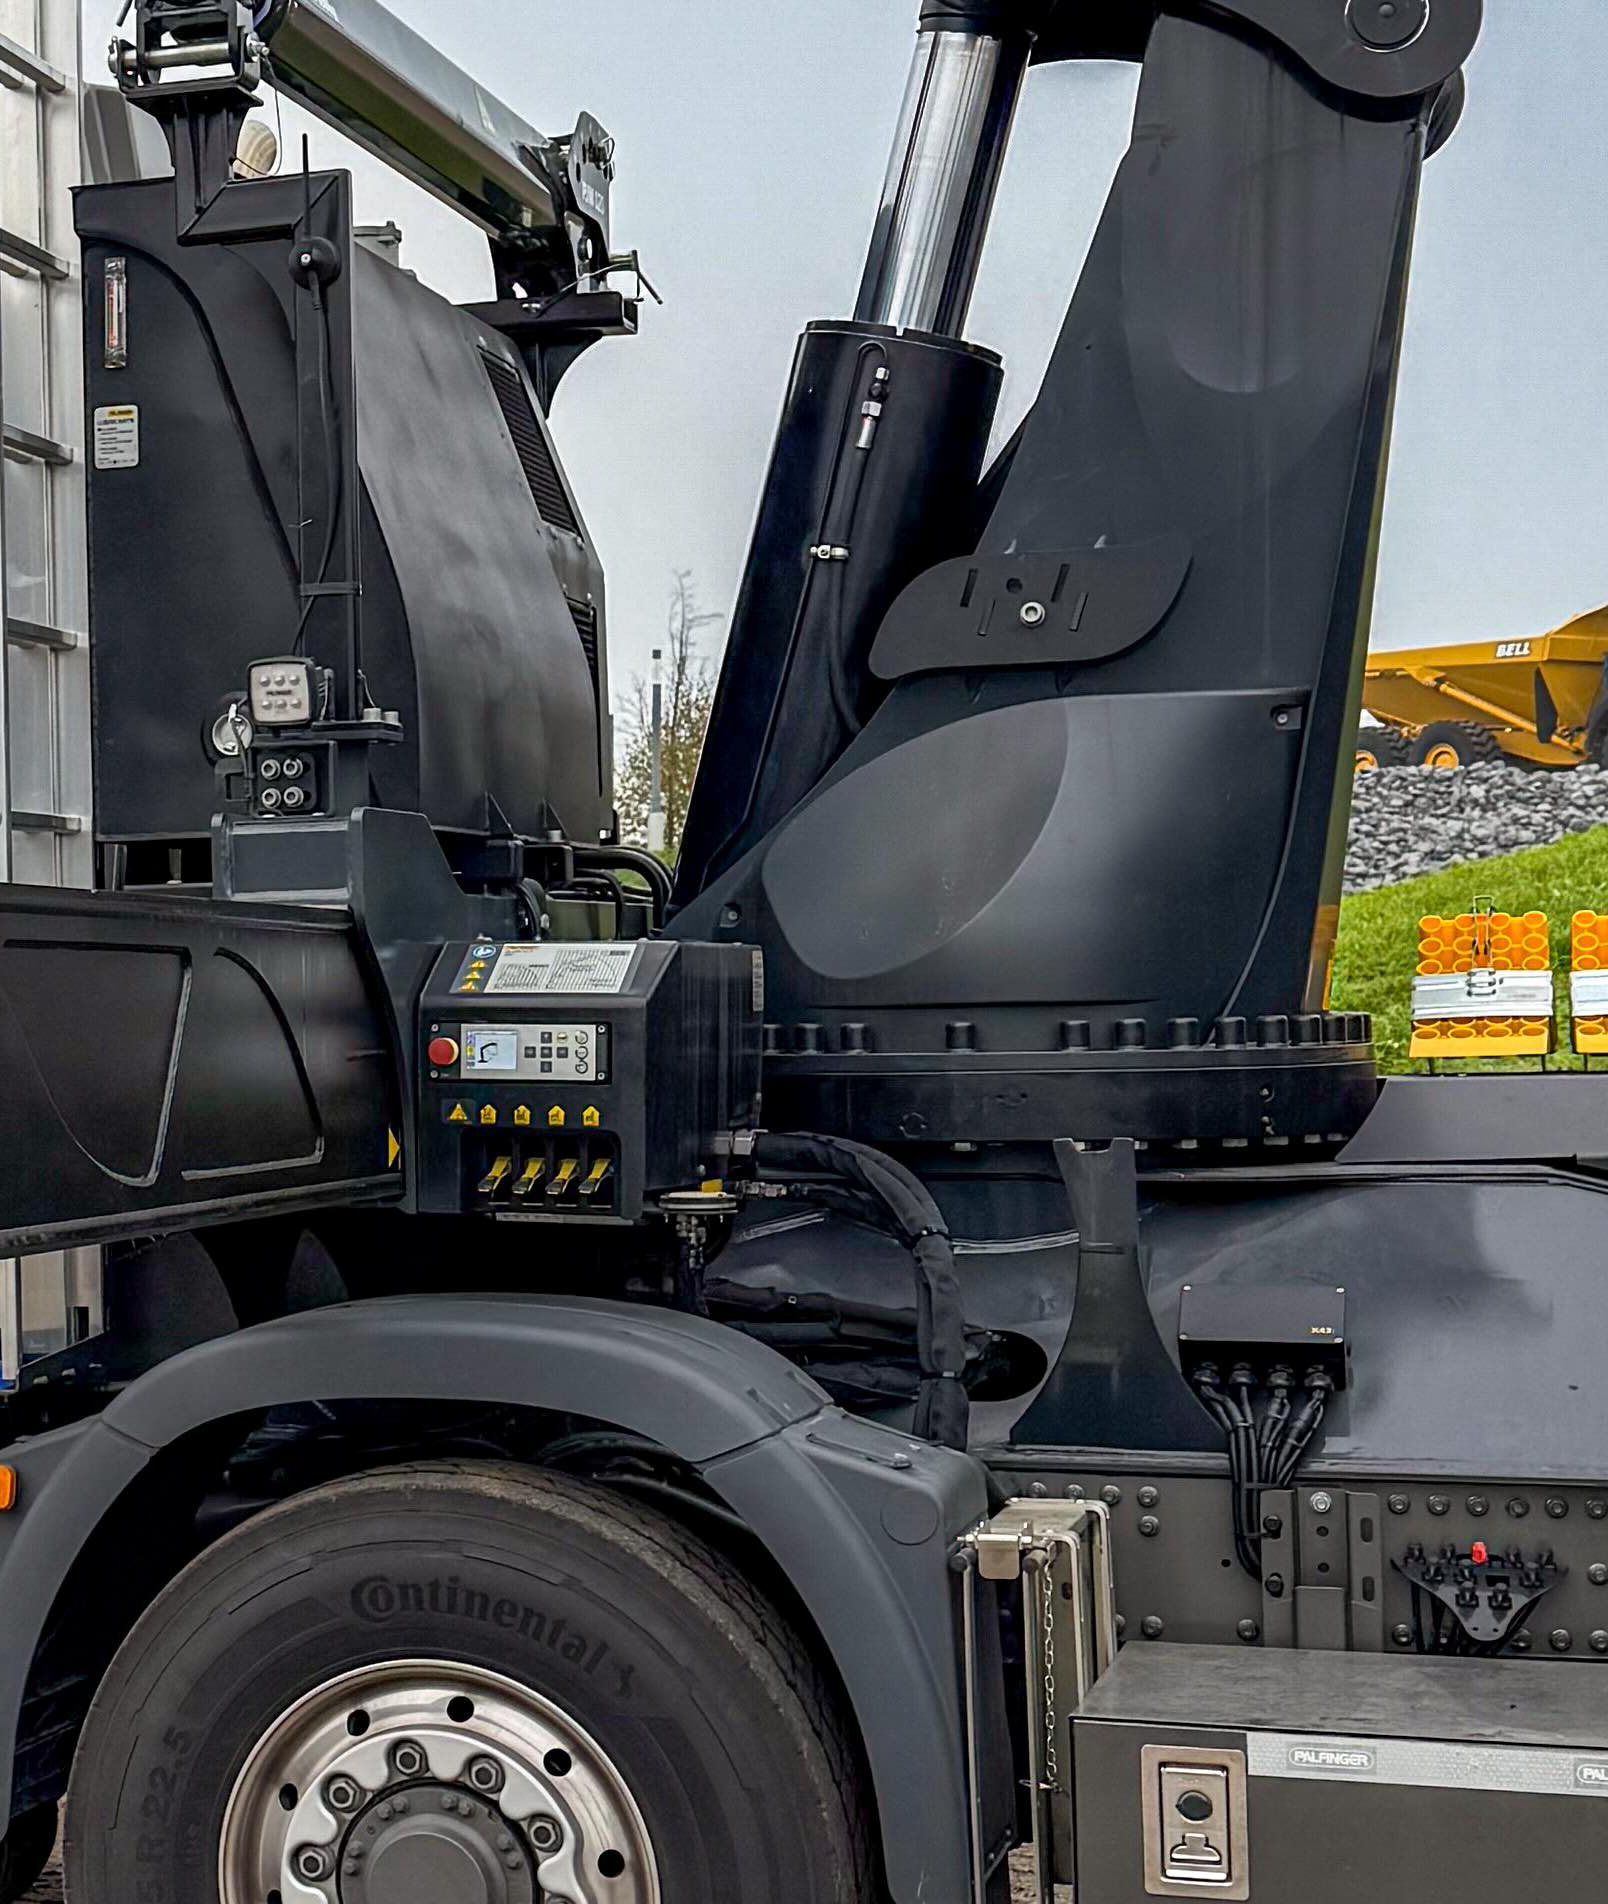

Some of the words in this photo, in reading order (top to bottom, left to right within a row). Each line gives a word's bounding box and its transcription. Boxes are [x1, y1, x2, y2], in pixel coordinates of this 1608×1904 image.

[1495, 641, 1530, 658] BELL
[349, 1572, 610, 1679] Continental
[1294, 1750, 1369, 1767] PALFINGER
